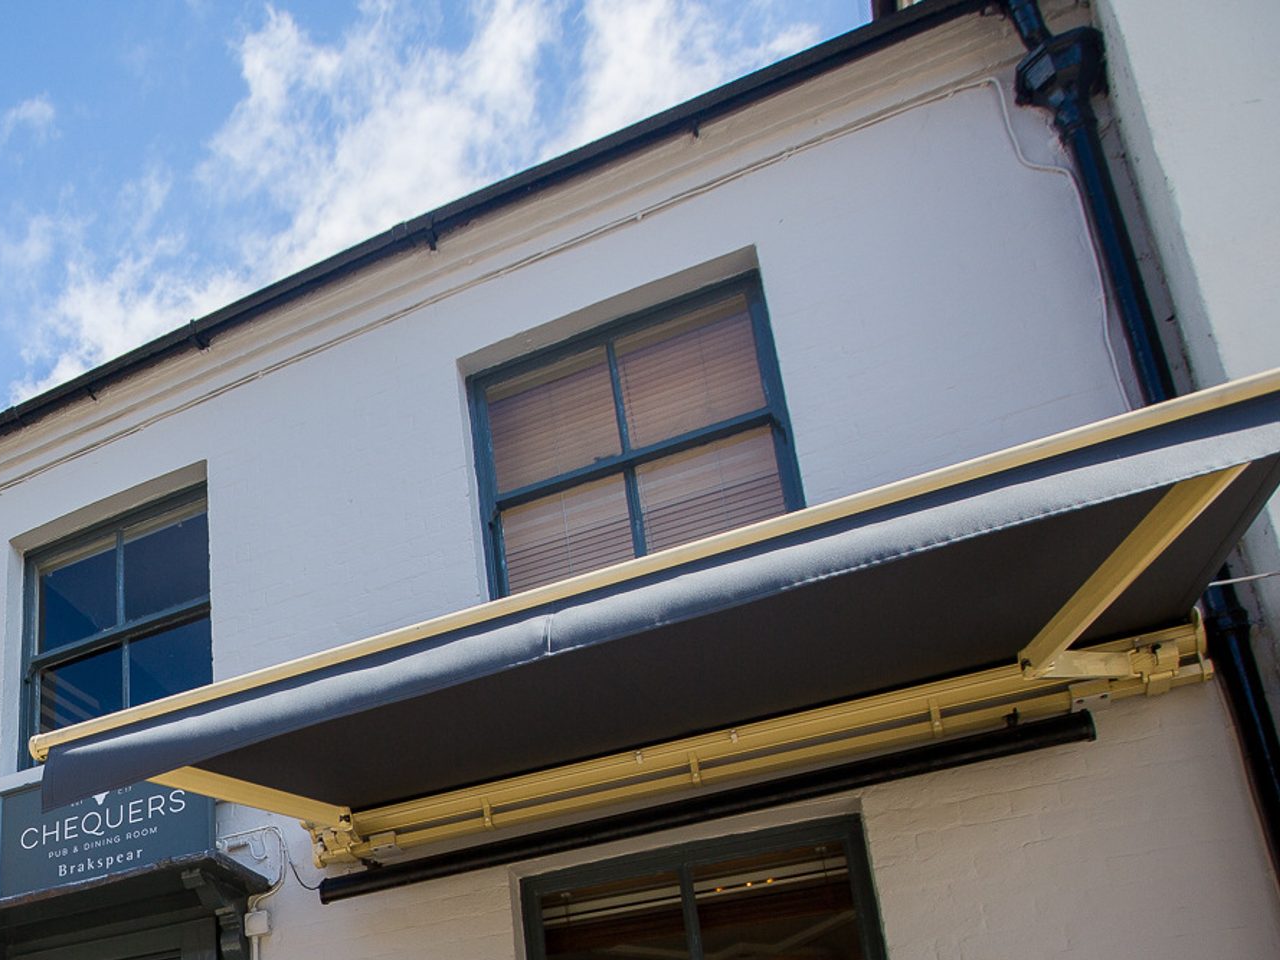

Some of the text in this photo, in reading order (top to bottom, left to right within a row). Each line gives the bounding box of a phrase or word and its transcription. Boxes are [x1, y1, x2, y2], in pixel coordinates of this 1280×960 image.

[20, 789, 186, 850] CHEQUERS
[48, 826, 158, 860] PUB & DINING ROOM
[58, 848, 144, 877] Brakspear
